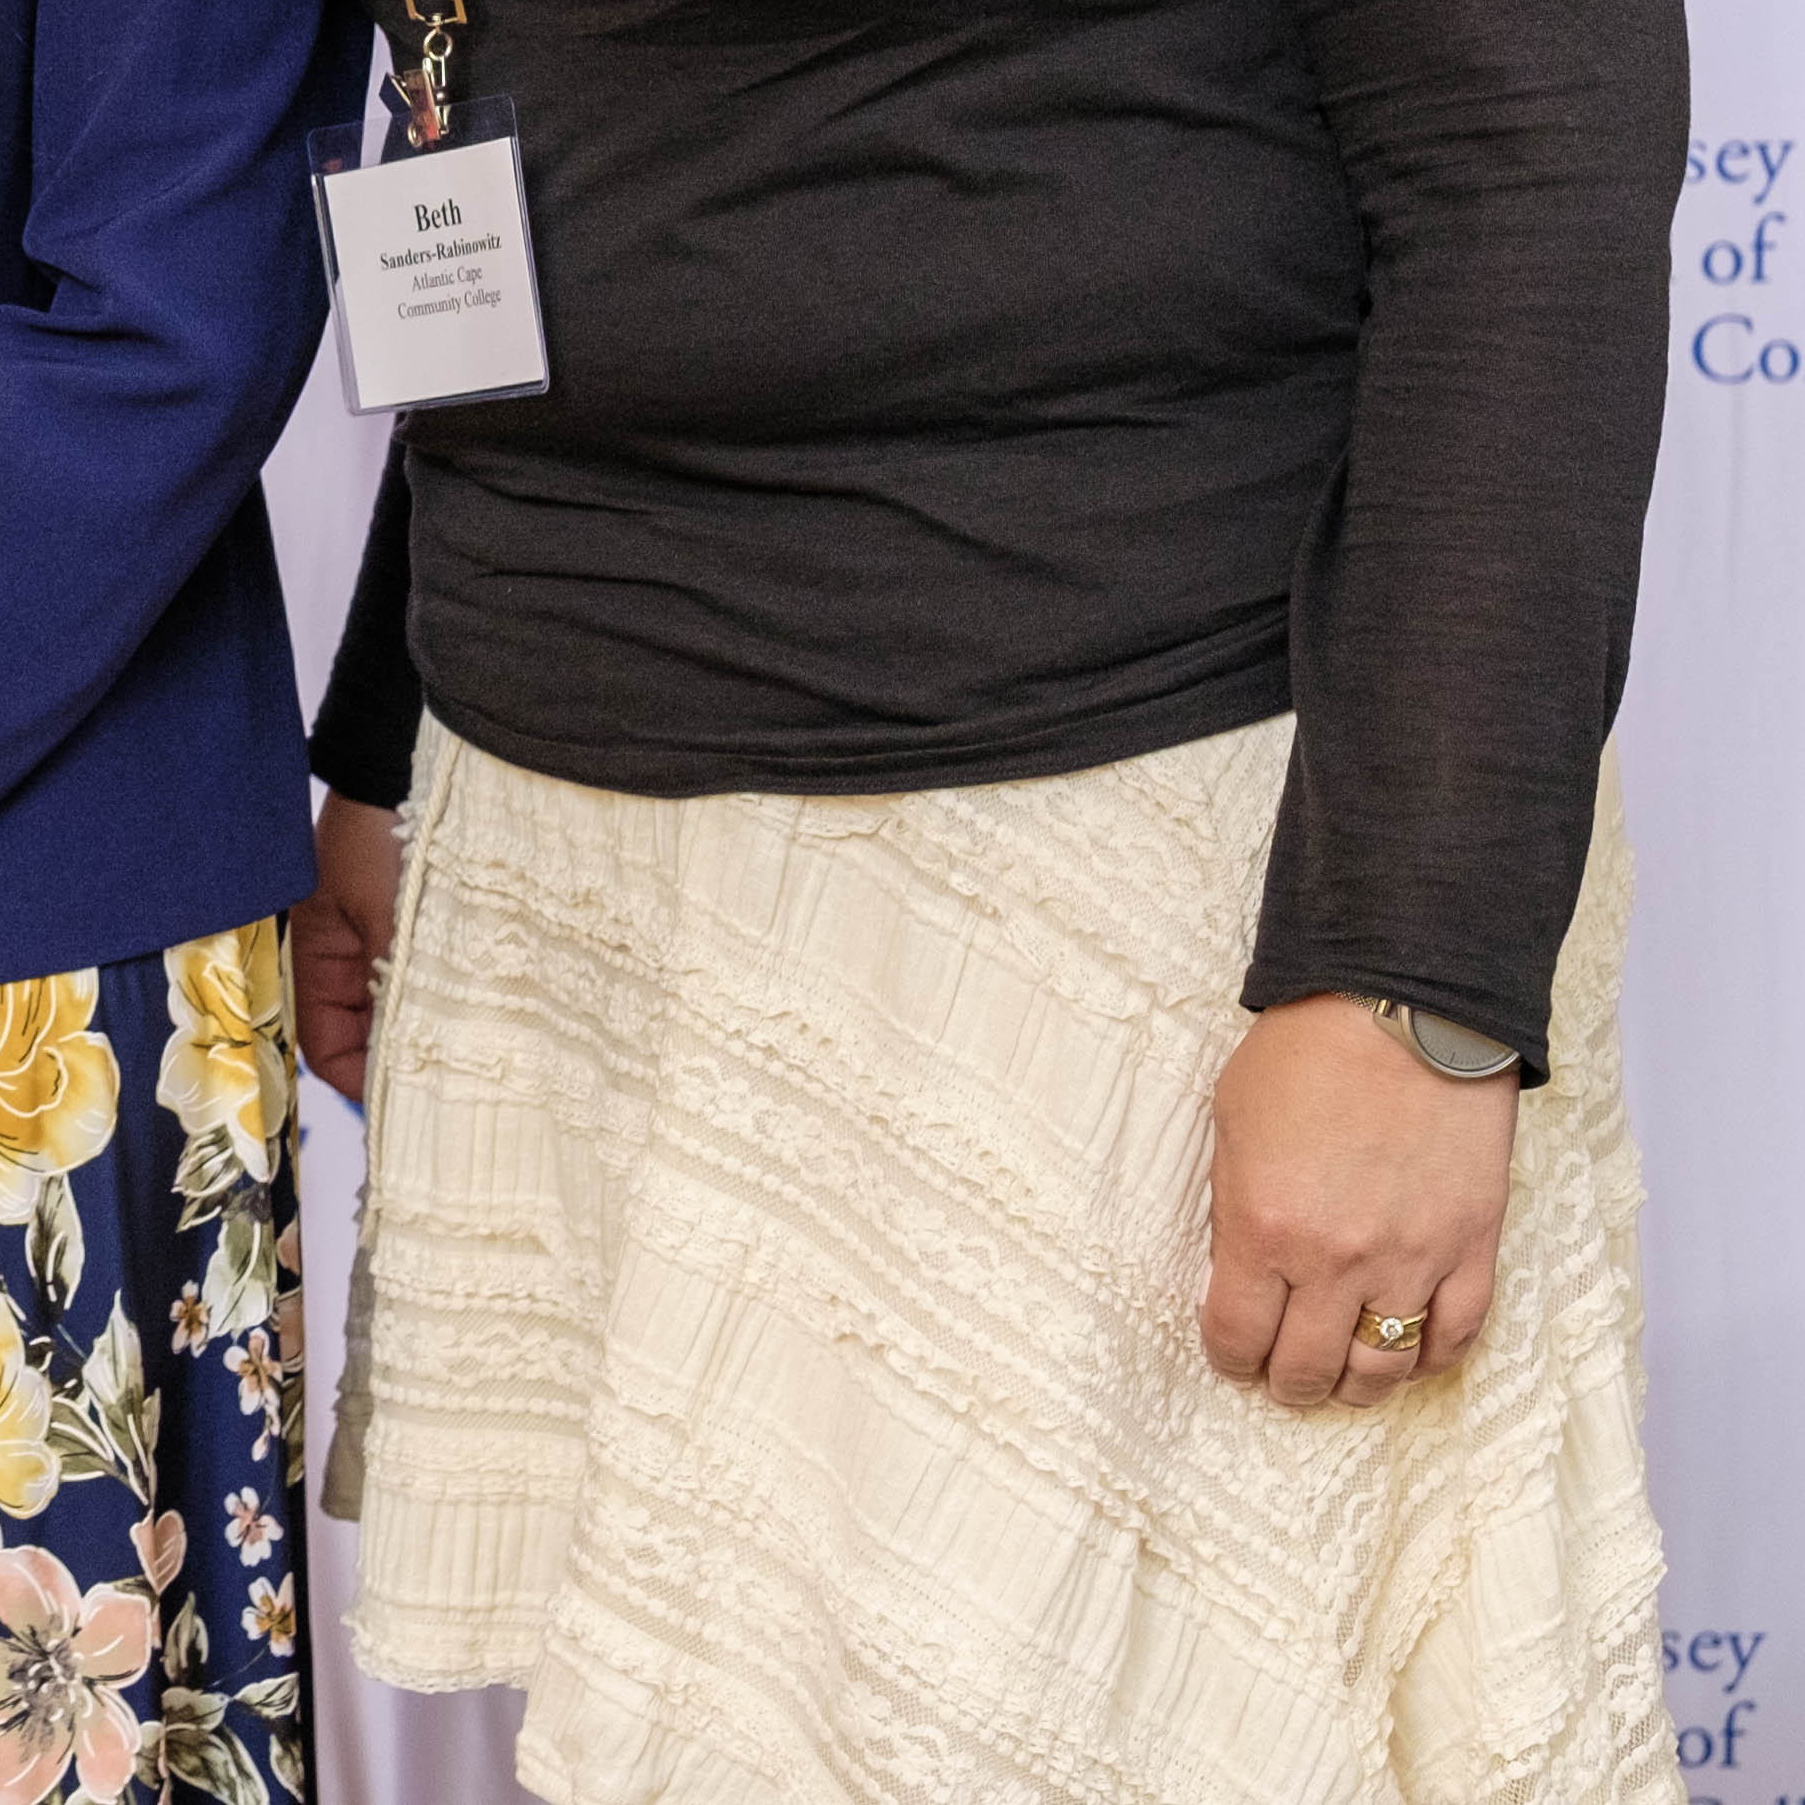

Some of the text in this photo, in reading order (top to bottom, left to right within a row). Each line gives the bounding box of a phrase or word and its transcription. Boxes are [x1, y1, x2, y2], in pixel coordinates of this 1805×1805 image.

[414, 198, 462, 233] Beth
[379, 231, 502, 272] Sanders-Rabinowitz
[1700, 209, 1787, 286] of
[412, 265, 483, 296] Atlantic Cape
[397, 288, 502, 320] Community College
[1677, 1699, 1756, 1771] of
